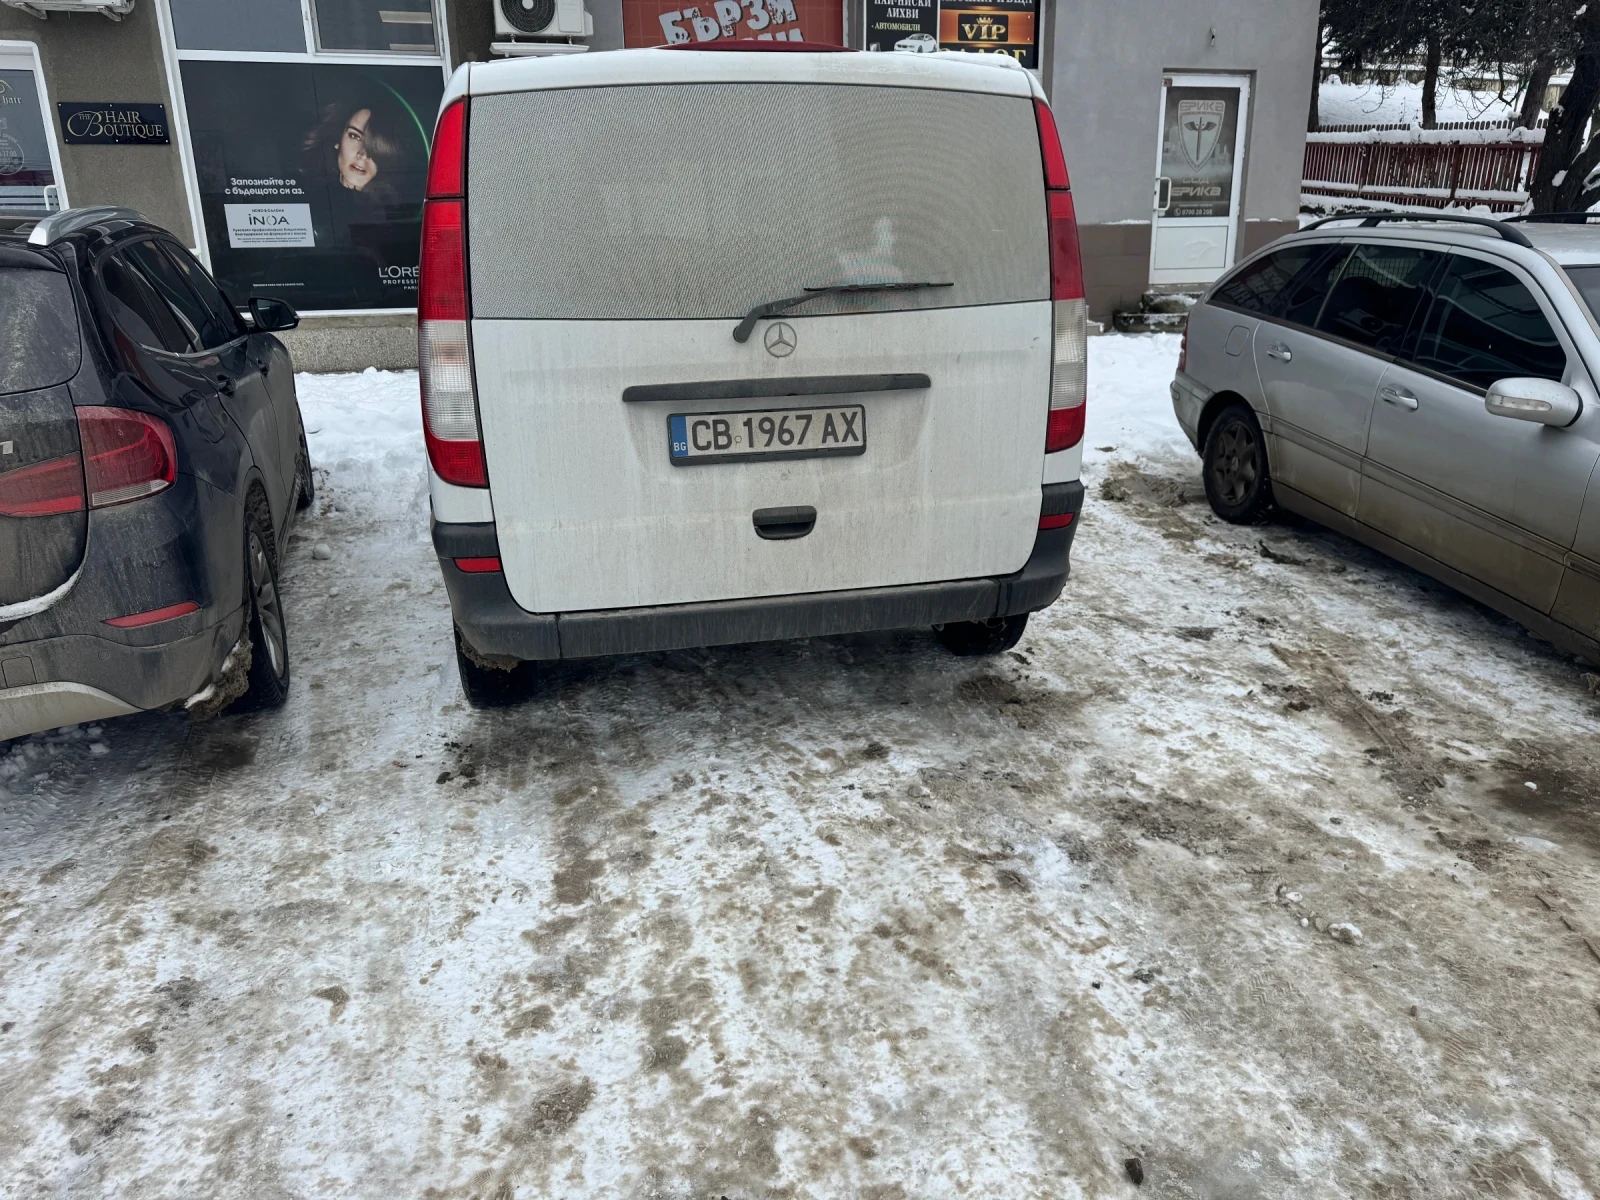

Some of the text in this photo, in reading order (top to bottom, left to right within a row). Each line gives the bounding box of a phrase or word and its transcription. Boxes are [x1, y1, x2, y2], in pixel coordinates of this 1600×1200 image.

[886, 7, 919, 19] ЛИХВИ
[659, 0, 798, 45] БЪРЗИ
[874, 22, 921, 32] АВТОМОБИЛИ
[961, 23, 1006, 40] VIP
[103, 110, 142, 123] HAIR
[67, 110, 164, 139] BOUTIQUE
[230, 177, 284, 186] Запознайте
[232, 186, 278, 196] бъдещото
[1181, 208, 1195, 216] 0700
[1195, 208, 1202, 216] 20
[691, 411, 859, 451] CB 1967 AX
[673, 442, 687, 452] BG
